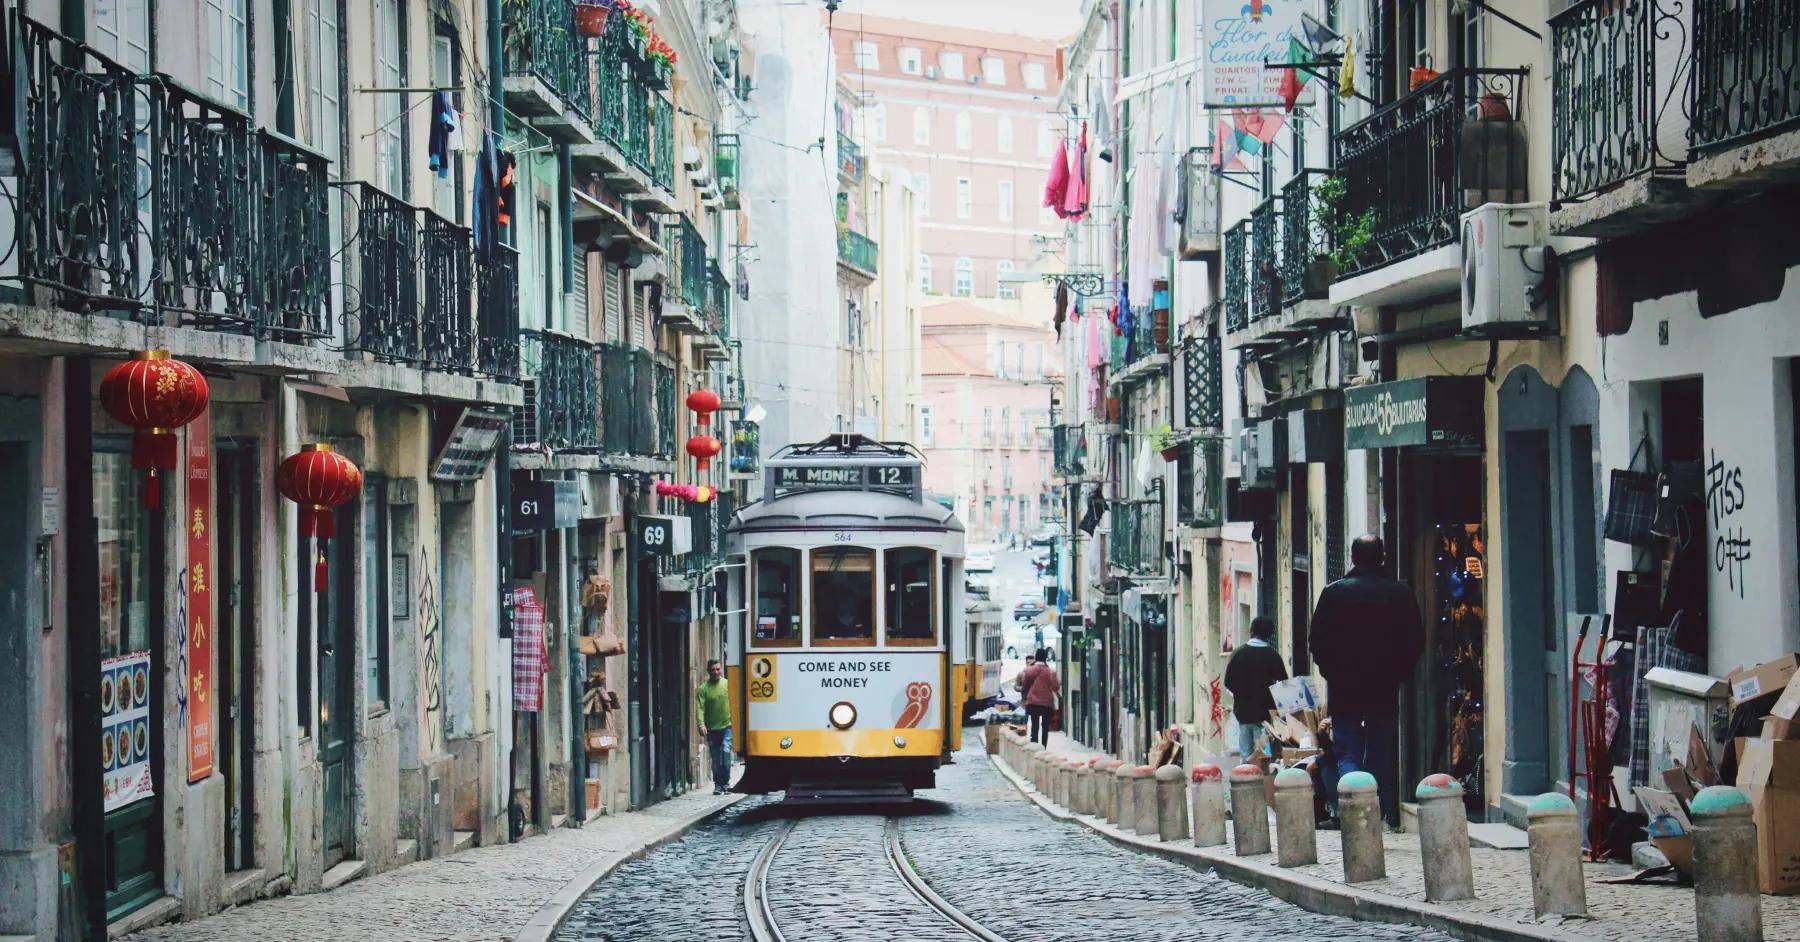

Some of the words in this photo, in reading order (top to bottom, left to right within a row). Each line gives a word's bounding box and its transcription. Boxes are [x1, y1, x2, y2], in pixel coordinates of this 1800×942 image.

[1214, 18, 1267, 43] Flor
[1215, 66, 1257, 74] QUARTOS
[1378, 391, 1392, 436] 56
[1391, 397, 1427, 426] BIJUTARIAS
[782, 468, 799, 480] M.
[807, 469, 860, 482] MONIZ
[878, 467, 901, 484] 12
[520, 500, 538, 515] 61
[644, 526, 665, 545] 69
[834, 533, 852, 542] 564
[798, 661, 835, 672] COME
[838, 661, 866, 672] AND
[869, 661, 891, 672] SEE
[821, 678, 868, 688] MONEY
